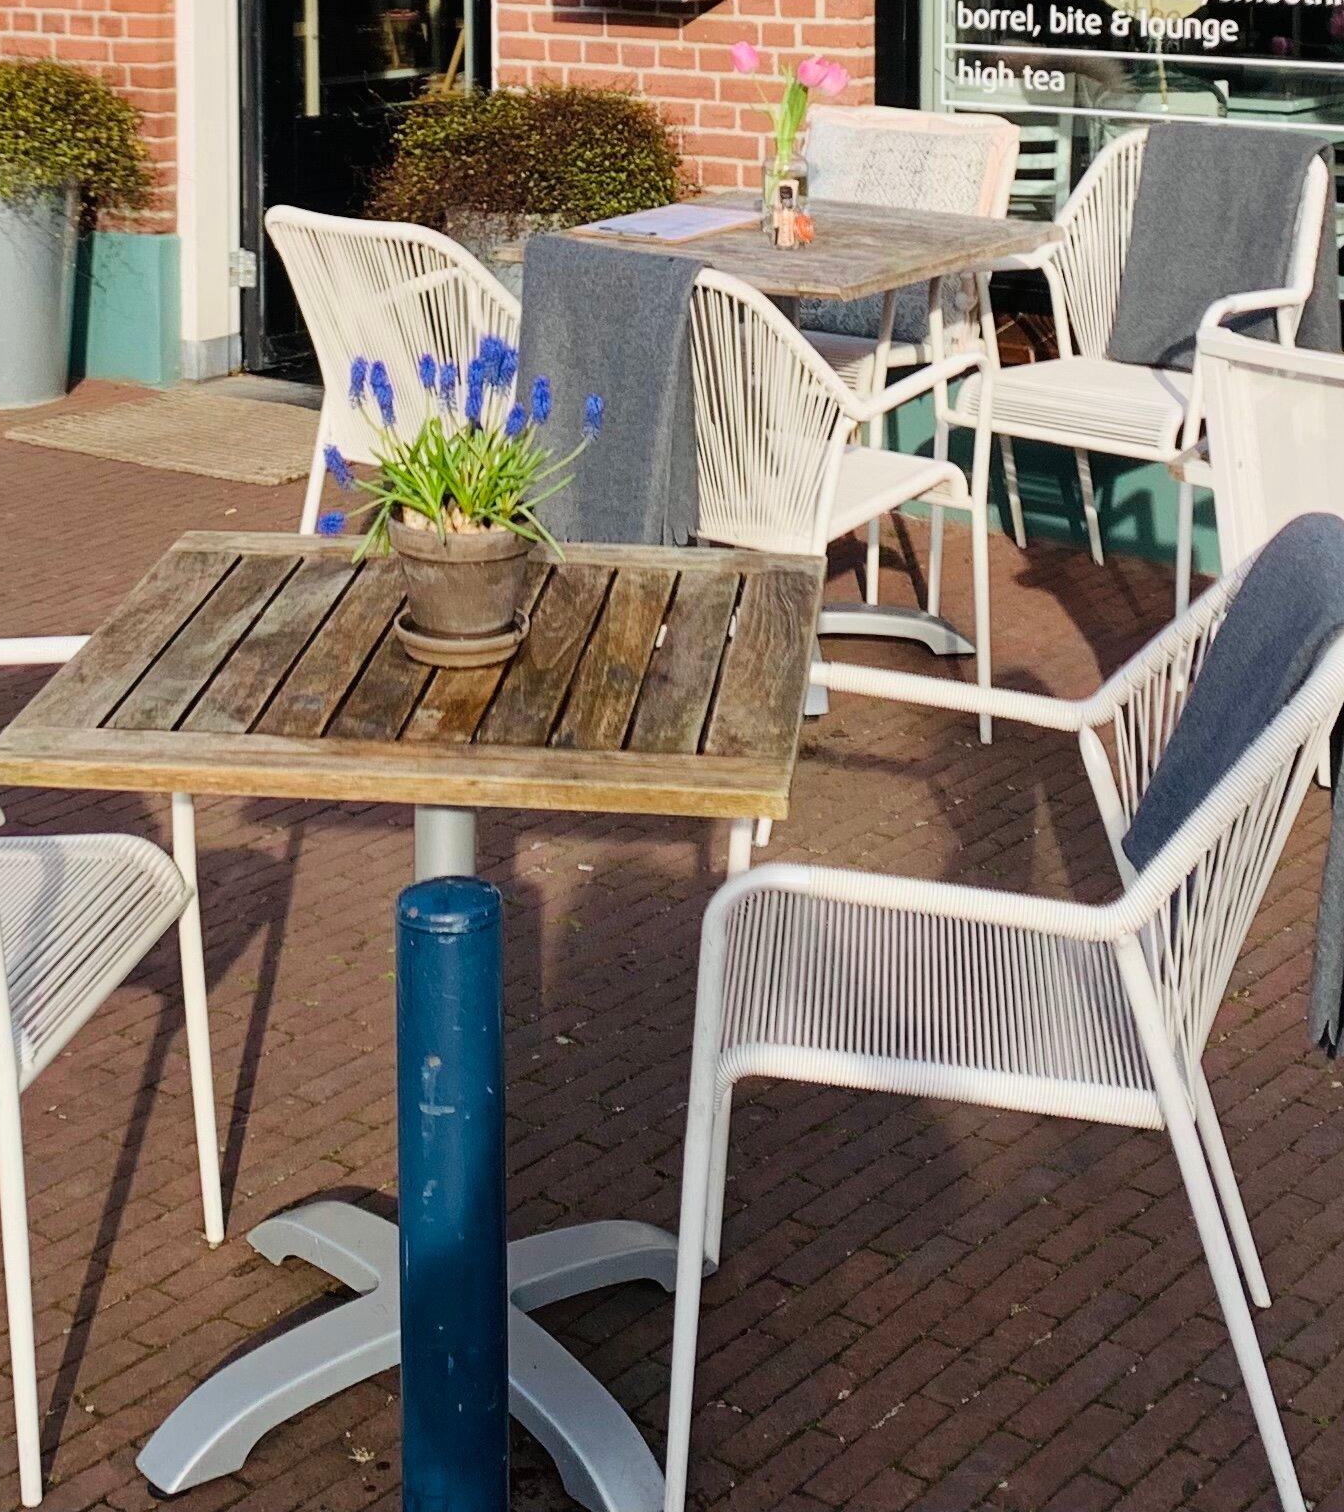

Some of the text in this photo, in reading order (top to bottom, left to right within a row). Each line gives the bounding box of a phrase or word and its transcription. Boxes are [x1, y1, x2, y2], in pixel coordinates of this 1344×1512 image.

[957, 0, 1240, 48] borrel, bite & lounge
[958, 57, 1066, 93] high tea
